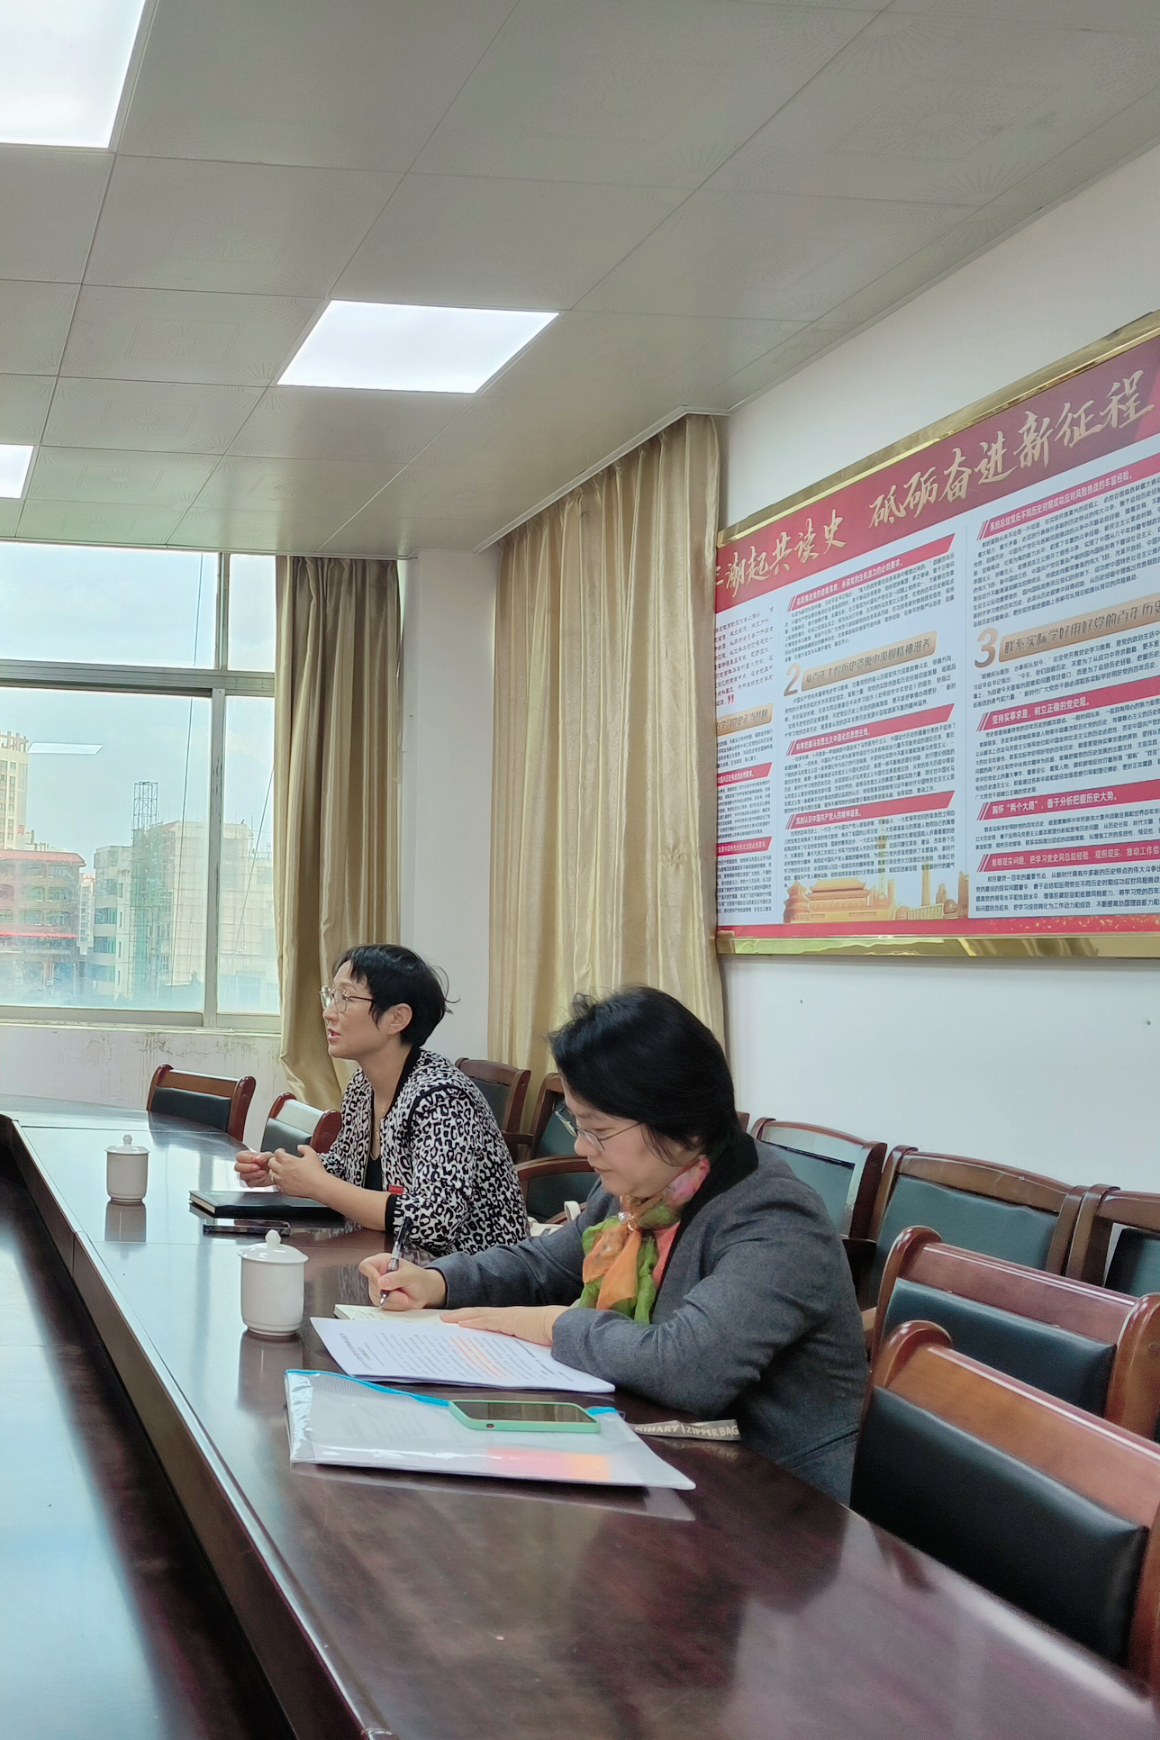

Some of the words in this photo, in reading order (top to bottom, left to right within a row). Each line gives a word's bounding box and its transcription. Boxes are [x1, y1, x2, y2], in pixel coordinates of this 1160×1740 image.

[868, 369, 1153, 532] 砥砺奋进新征程
[974, 625, 998, 669] 3
[784, 660, 801, 697] 2
[992, 695, 1089, 725] 坚持实事求是，树立正确的党史观。
[992, 789, 1116, 815] 胸怀“两个大局”，善于分析把握历史大势。
[719, 1426, 740, 1437] BAG
